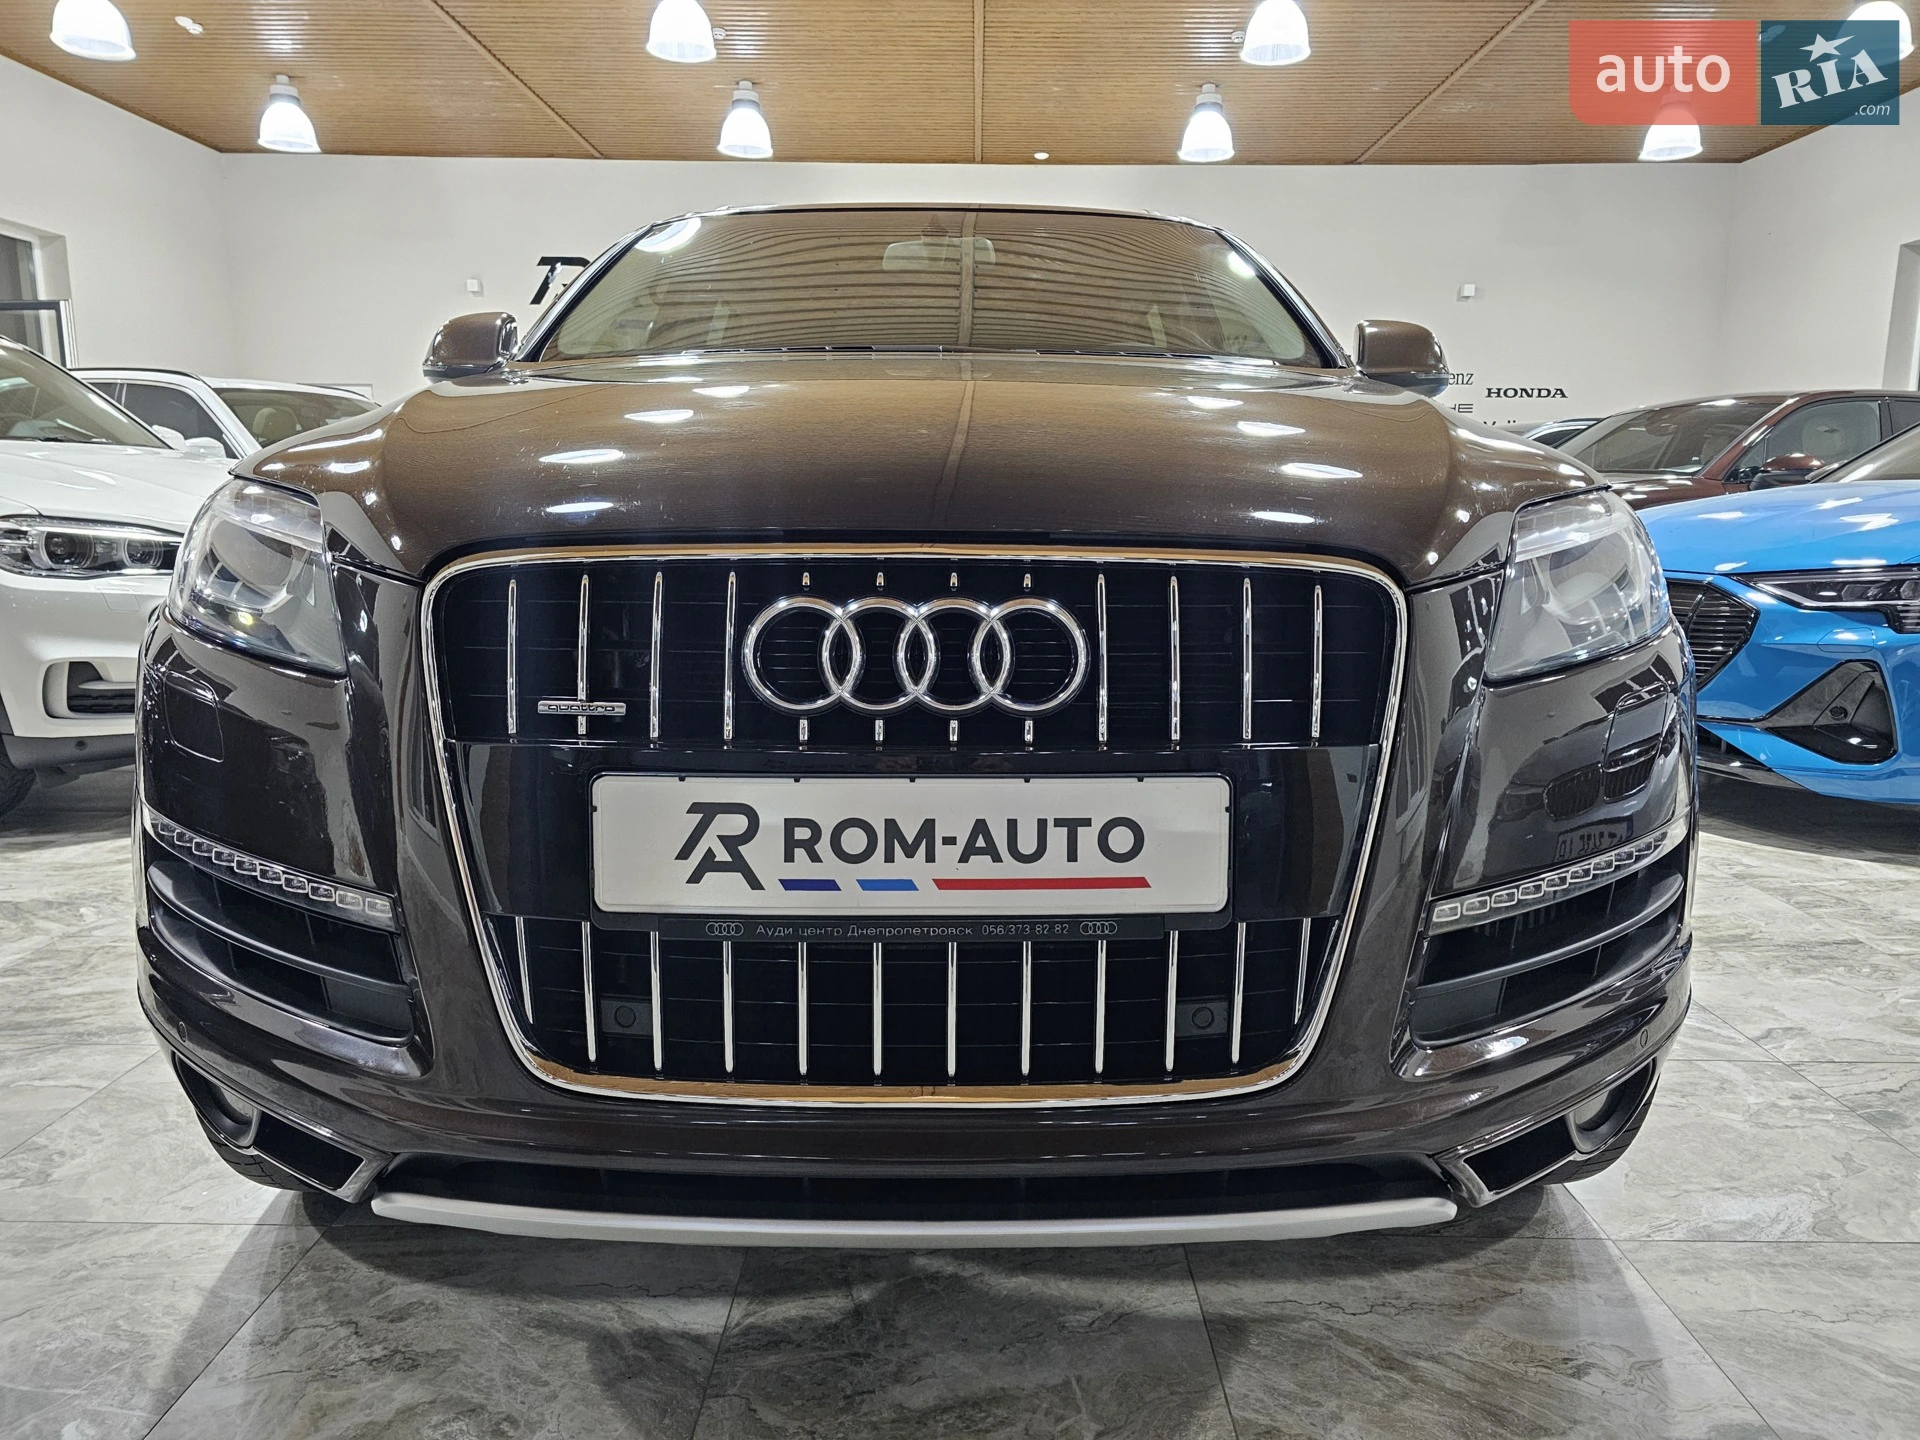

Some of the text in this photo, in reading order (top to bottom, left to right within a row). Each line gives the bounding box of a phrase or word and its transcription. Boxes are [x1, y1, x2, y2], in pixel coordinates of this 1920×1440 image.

[1485, 387, 1569, 399] HONDA
[547, 704, 616, 713] quattro
[783, 816, 1146, 864] ROM-AUTO
[847, 924, 973, 937] Днепропетровск
